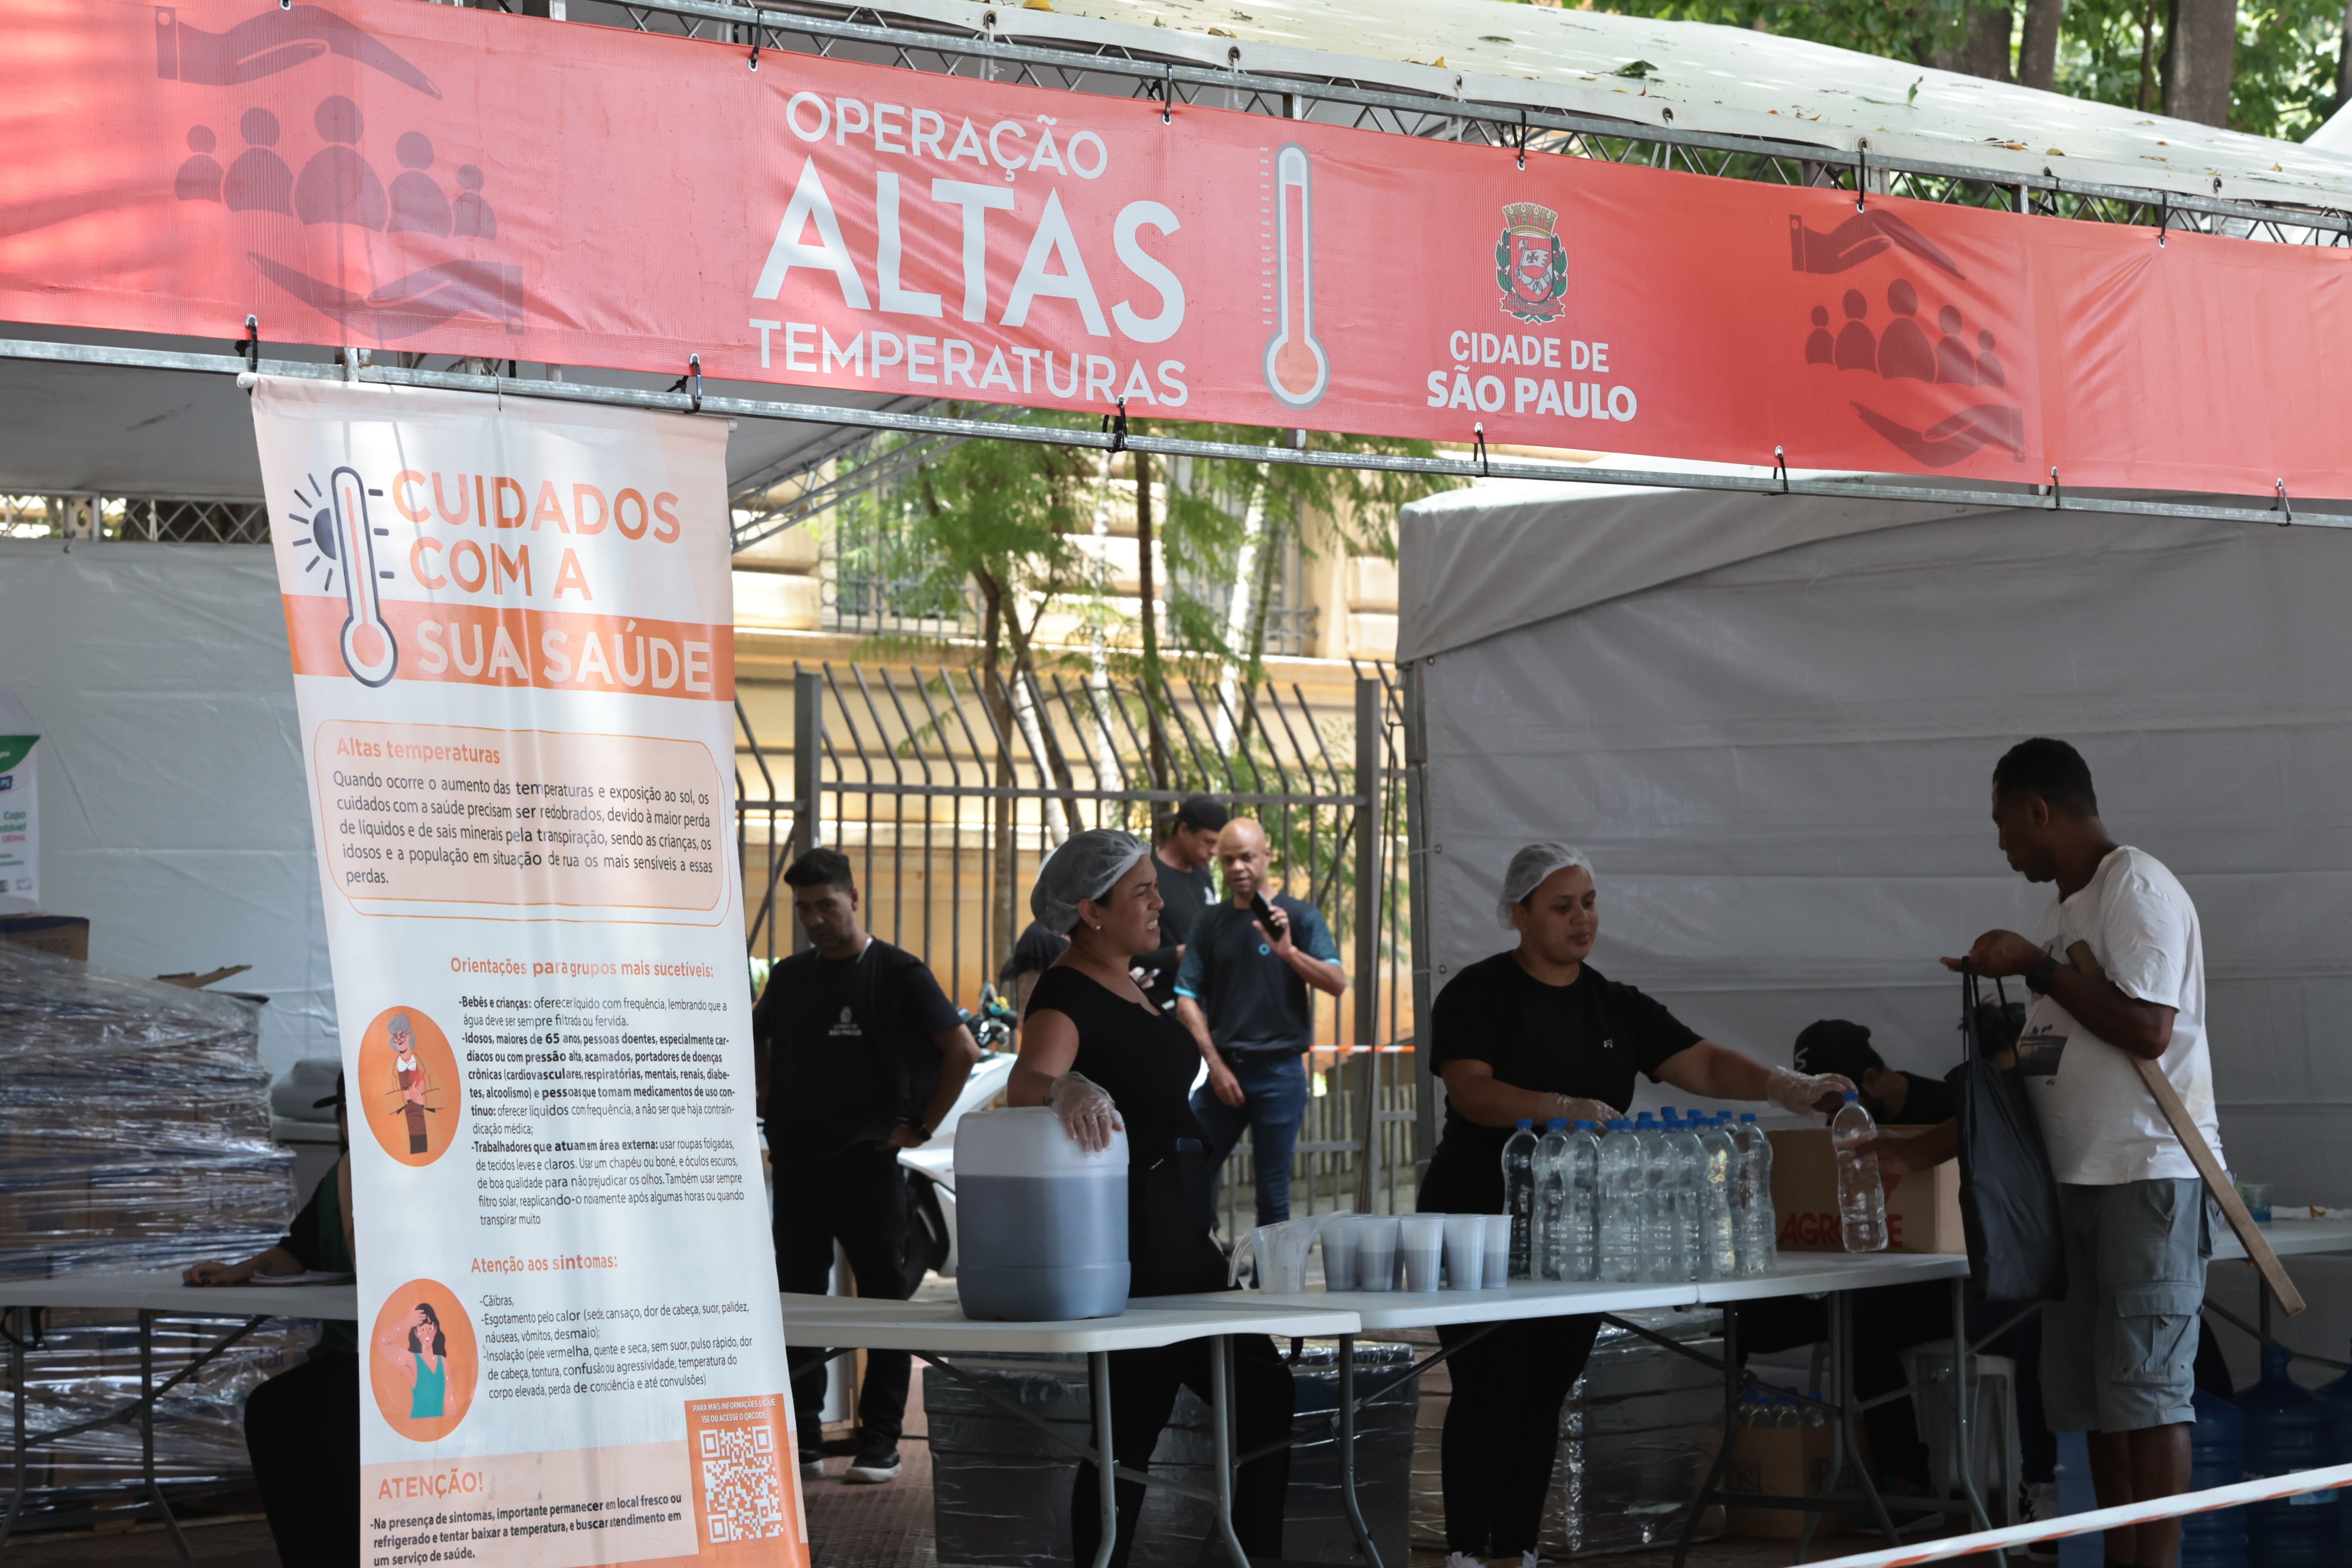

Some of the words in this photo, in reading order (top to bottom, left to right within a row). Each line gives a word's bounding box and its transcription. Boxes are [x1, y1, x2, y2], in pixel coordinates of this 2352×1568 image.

[786, 90, 1108, 181] OPERAÇÃO
[753, 154, 1185, 344] ALTAS
[750, 318, 1188, 407] TEMPERATURAS
[1450, 331, 1561, 368] CIDADE
[1571, 340, 1609, 373] DE
[1427, 364, 1505, 413] SÃO
[1515, 377, 1637, 422] PAULO
[392, 469, 681, 544] CUIDADOS
[410, 536, 533, 597] COM
[553, 548, 593, 601] A
[417, 620, 529, 679] SUA
[542, 620, 711, 692] SAÚDE
[337, 737, 381, 758] Altas
[387, 740, 500, 765] temperaturas
[334, 770, 382, 788] Quando
[387, 777, 424, 789] ocorre
[429, 779, 436, 790] o
[442, 779, 490, 793] aumento
[494, 779, 510, 795] das
[515, 782, 593, 798] temperaturas
[599, 786, 605, 798] e
[610, 786, 661, 803] exposição
[665, 790, 676, 802] ao
[680, 789, 695, 805] sol,
[698, 793, 709, 805] os
[337, 795, 390, 812] cuidados
[393, 801, 418, 813] com
[422, 802, 428, 813] a
[431, 799, 464, 815] saúde
[468, 802, 512, 819] precisam
[515, 806, 536, 818] ser
[540, 805, 605, 822] redobrados,
[607, 807, 643, 823] devido
[646, 809, 652, 824] à
[654, 811, 681, 825] maior
[684, 813, 710, 829] perda
[340, 819, 355, 834] de
[359, 819, 404, 838] líquidos
[408, 825, 414, 837] e
[418, 822, 433, 838] de
[437, 824, 457, 838] sais
[460, 825, 503, 841] minerais
[506, 827, 532, 845] pela
[537, 828, 607, 847] transpiração,
[611, 831, 643, 846] sendo
[646, 835, 656, 847] as
[659, 835, 698, 852] crianças,
[701, 839, 711, 850] os
[342, 843, 381, 859] idosos
[386, 848, 393, 860] e
[397, 849, 404, 860] a
[409, 847, 469, 865] população
[473, 852, 489, 864] em
[493, 850, 542, 869] situação
[548, 851, 560, 865] de
[563, 855, 579, 867] rua
[584, 856, 598, 867] os
[604, 854, 629, 868] mais
[633, 855, 677, 870] sensíveis
[680, 860, 685, 871] a
[690, 860, 713, 873] essas
[346, 868, 388, 886] perdas.
[451, 957, 527, 976] Orientações
[533, 962, 568, 977] para
[570, 962, 616, 978] grupos
[621, 961, 651, 975] mais
[654, 962, 713, 978] sucetíveis:
[459, 996, 488, 1007] -Bebês
[496, 997, 532, 1011] crianças:
[534, 997, 572, 1008] oferecer
[573, 998, 600, 1011] líquido
[602, 1000, 622, 1008] com
[623, 997, 667, 1011] frequência,
[668, 998, 707, 1011] lembrando
[708, 1002, 721, 1013] que
[723, 1002, 727, 1011] a
[463, 1014, 484, 1028] água
[485, 1014, 504, 1025] deve
[505, 1017, 515, 1026] ser
[518, 1017, 552, 1028] sempre
[555, 1014, 581, 1026] filtrada
[583, 1018, 593, 1027] ou
[595, 1015, 629, 1027] fervida.
[496, 1033, 528, 1044] maiores
[530, 1033, 543, 1044] de
[545, 1033, 560, 1044] 65
[563, 1035, 582, 1045] anos,
[583, 1035, 619, 1047] pessoas
[622, 1033, 658, 1045] doentes,
[659, 1034, 714, 1046] especialmente
[716, 1037, 729, 1046] car-
[471, 1256, 524, 1275] Atenção
[528, 1259, 548, 1271] aos
[553, 1255, 618, 1269] sintomas:
[481, 1313, 536, 1327] -Esgotamento
[538, 1311, 554, 1325] pelo
[556, 1309, 580, 1321] calor
[584, 1308, 605, 1321] (sede,
[606, 1308, 642, 1320] cansaço,
[643, 1305, 658, 1317] dor
[661, 1305, 671, 1316] de
[672, 1304, 701, 1317] cabeça,
[703, 1306, 720, 1315] suor,
[722, 1301, 749, 1314] palidez,
[485, 1332, 520, 1344] náuseas,
[521, 1330, 553, 1342] vômitos,
[554, 1327, 600, 1340] desmaio);
[720, 1413, 738, 1422] ACESSE
[721, 1399, 758, 1410] INFORMAÇÕES
[759, 1399, 776, 1407] LIGUE
[378, 1468, 484, 1500] ATENÇÃO!
[370, 1518, 386, 1530] -Na
[389, 1514, 433, 1531] presença
[436, 1513, 447, 1524] de
[449, 1510, 495, 1523] sintomas,
[496, 1505, 548, 1521] importante
[550, 1502, 603, 1517] permanecer
[606, 1500, 616, 1510] em
[618, 1496, 639, 1508] local
[641, 1495, 668, 1506] fresco
[671, 1494, 681, 1504] ou
[374, 1533, 430, 1549] refrigerado
[432, 1534, 437, 1543] e
[440, 1530, 469, 1543] tentar
[472, 1527, 501, 1540] baixar
[503, 1528, 508, 1536] a
[510, 1521, 568, 1537] temperatura,
[570, 1522, 574, 1531] e
[576, 1518, 608, 1530] buscar
[610, 1512, 665, 1527] atendimento
[668, 1512, 681, 1521] em
[374, 1557, 389, 1566] um
[393, 1551, 427, 1566] serviço
[430, 1550, 441, 1562] de
[443, 1547, 475, 1560] saúde.
